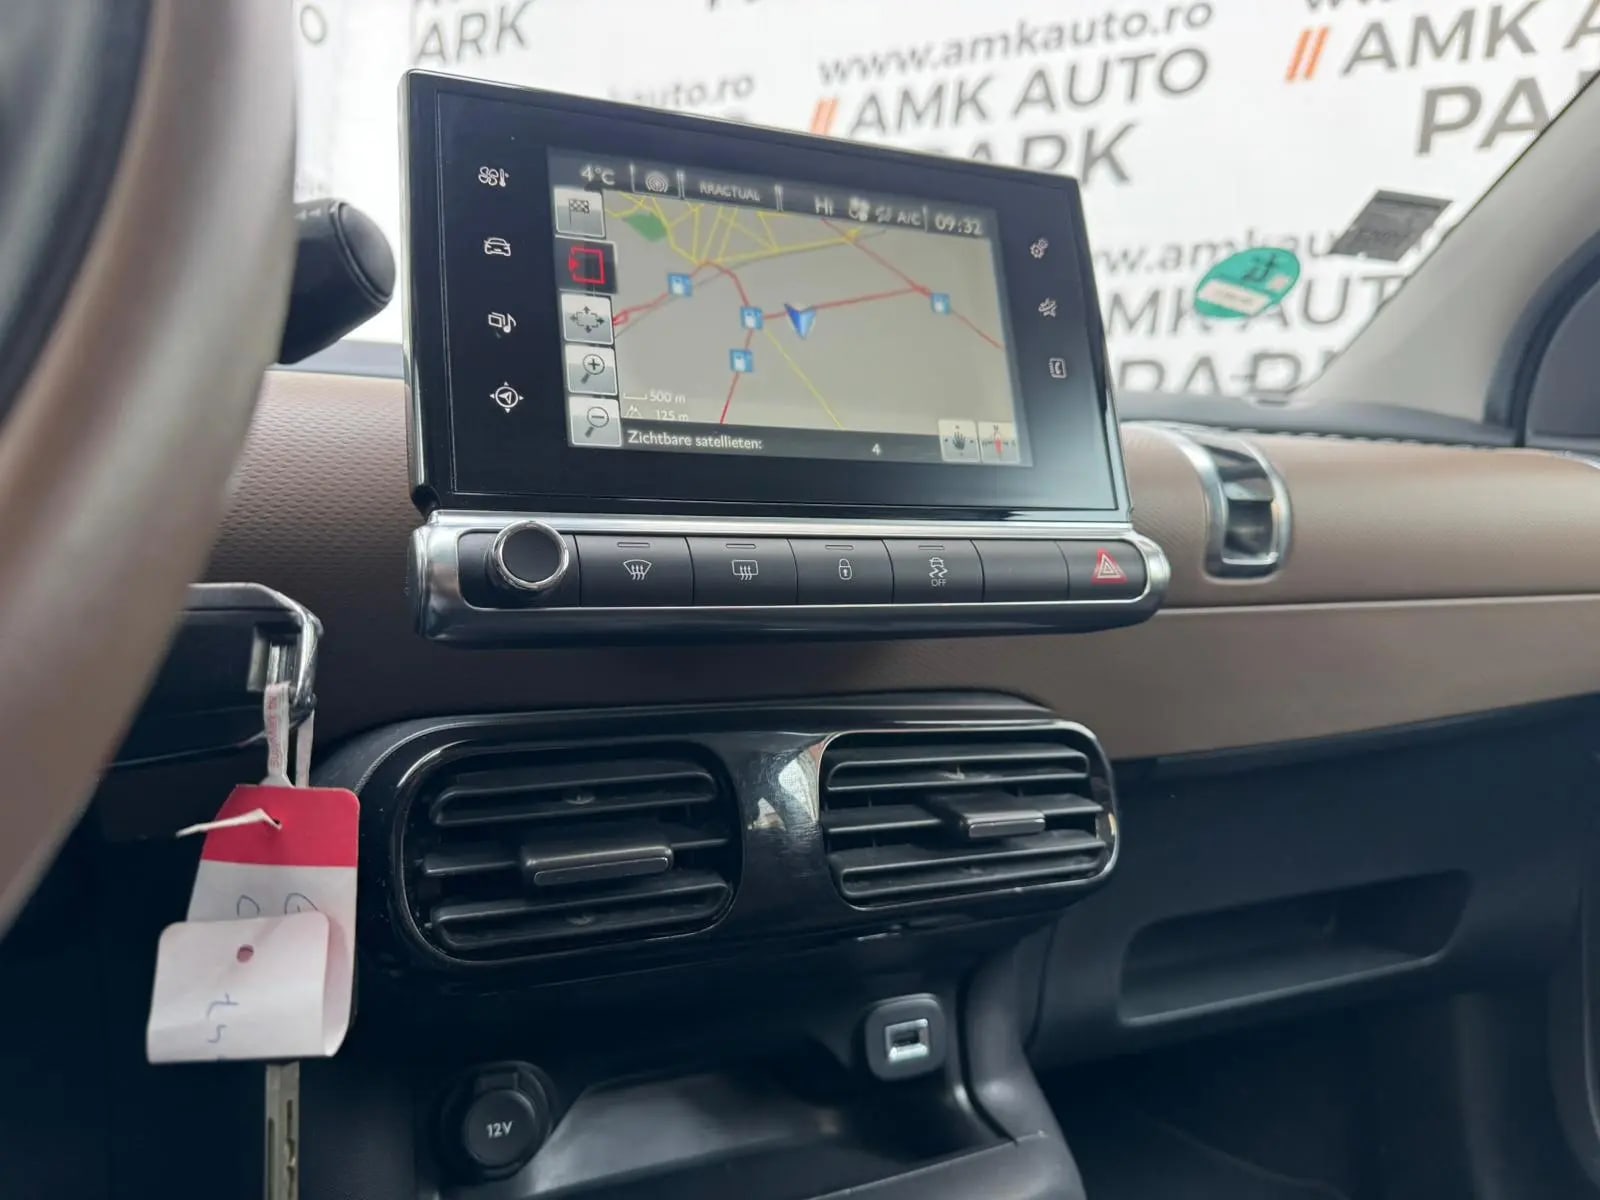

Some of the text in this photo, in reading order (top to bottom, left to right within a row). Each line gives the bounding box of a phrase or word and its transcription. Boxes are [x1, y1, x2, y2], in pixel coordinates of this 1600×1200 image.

[817, 1, 1213, 85] www.amkauto.ro
[1339, 0, 1546, 77] AMK
[849, 47, 1210, 138] AMK AUTO
[581, 164, 615, 186] 4°C
[934, 212, 983, 235] 09:32
[650, 389, 686, 404] 500 m
[656, 408, 689, 422] 125 m
[626, 429, 764, 450] Zichtbare satellieten:
[872, 442, 882, 457] 4
[931, 578, 947, 588] OFF
[486, 1120, 513, 1139] 12V
